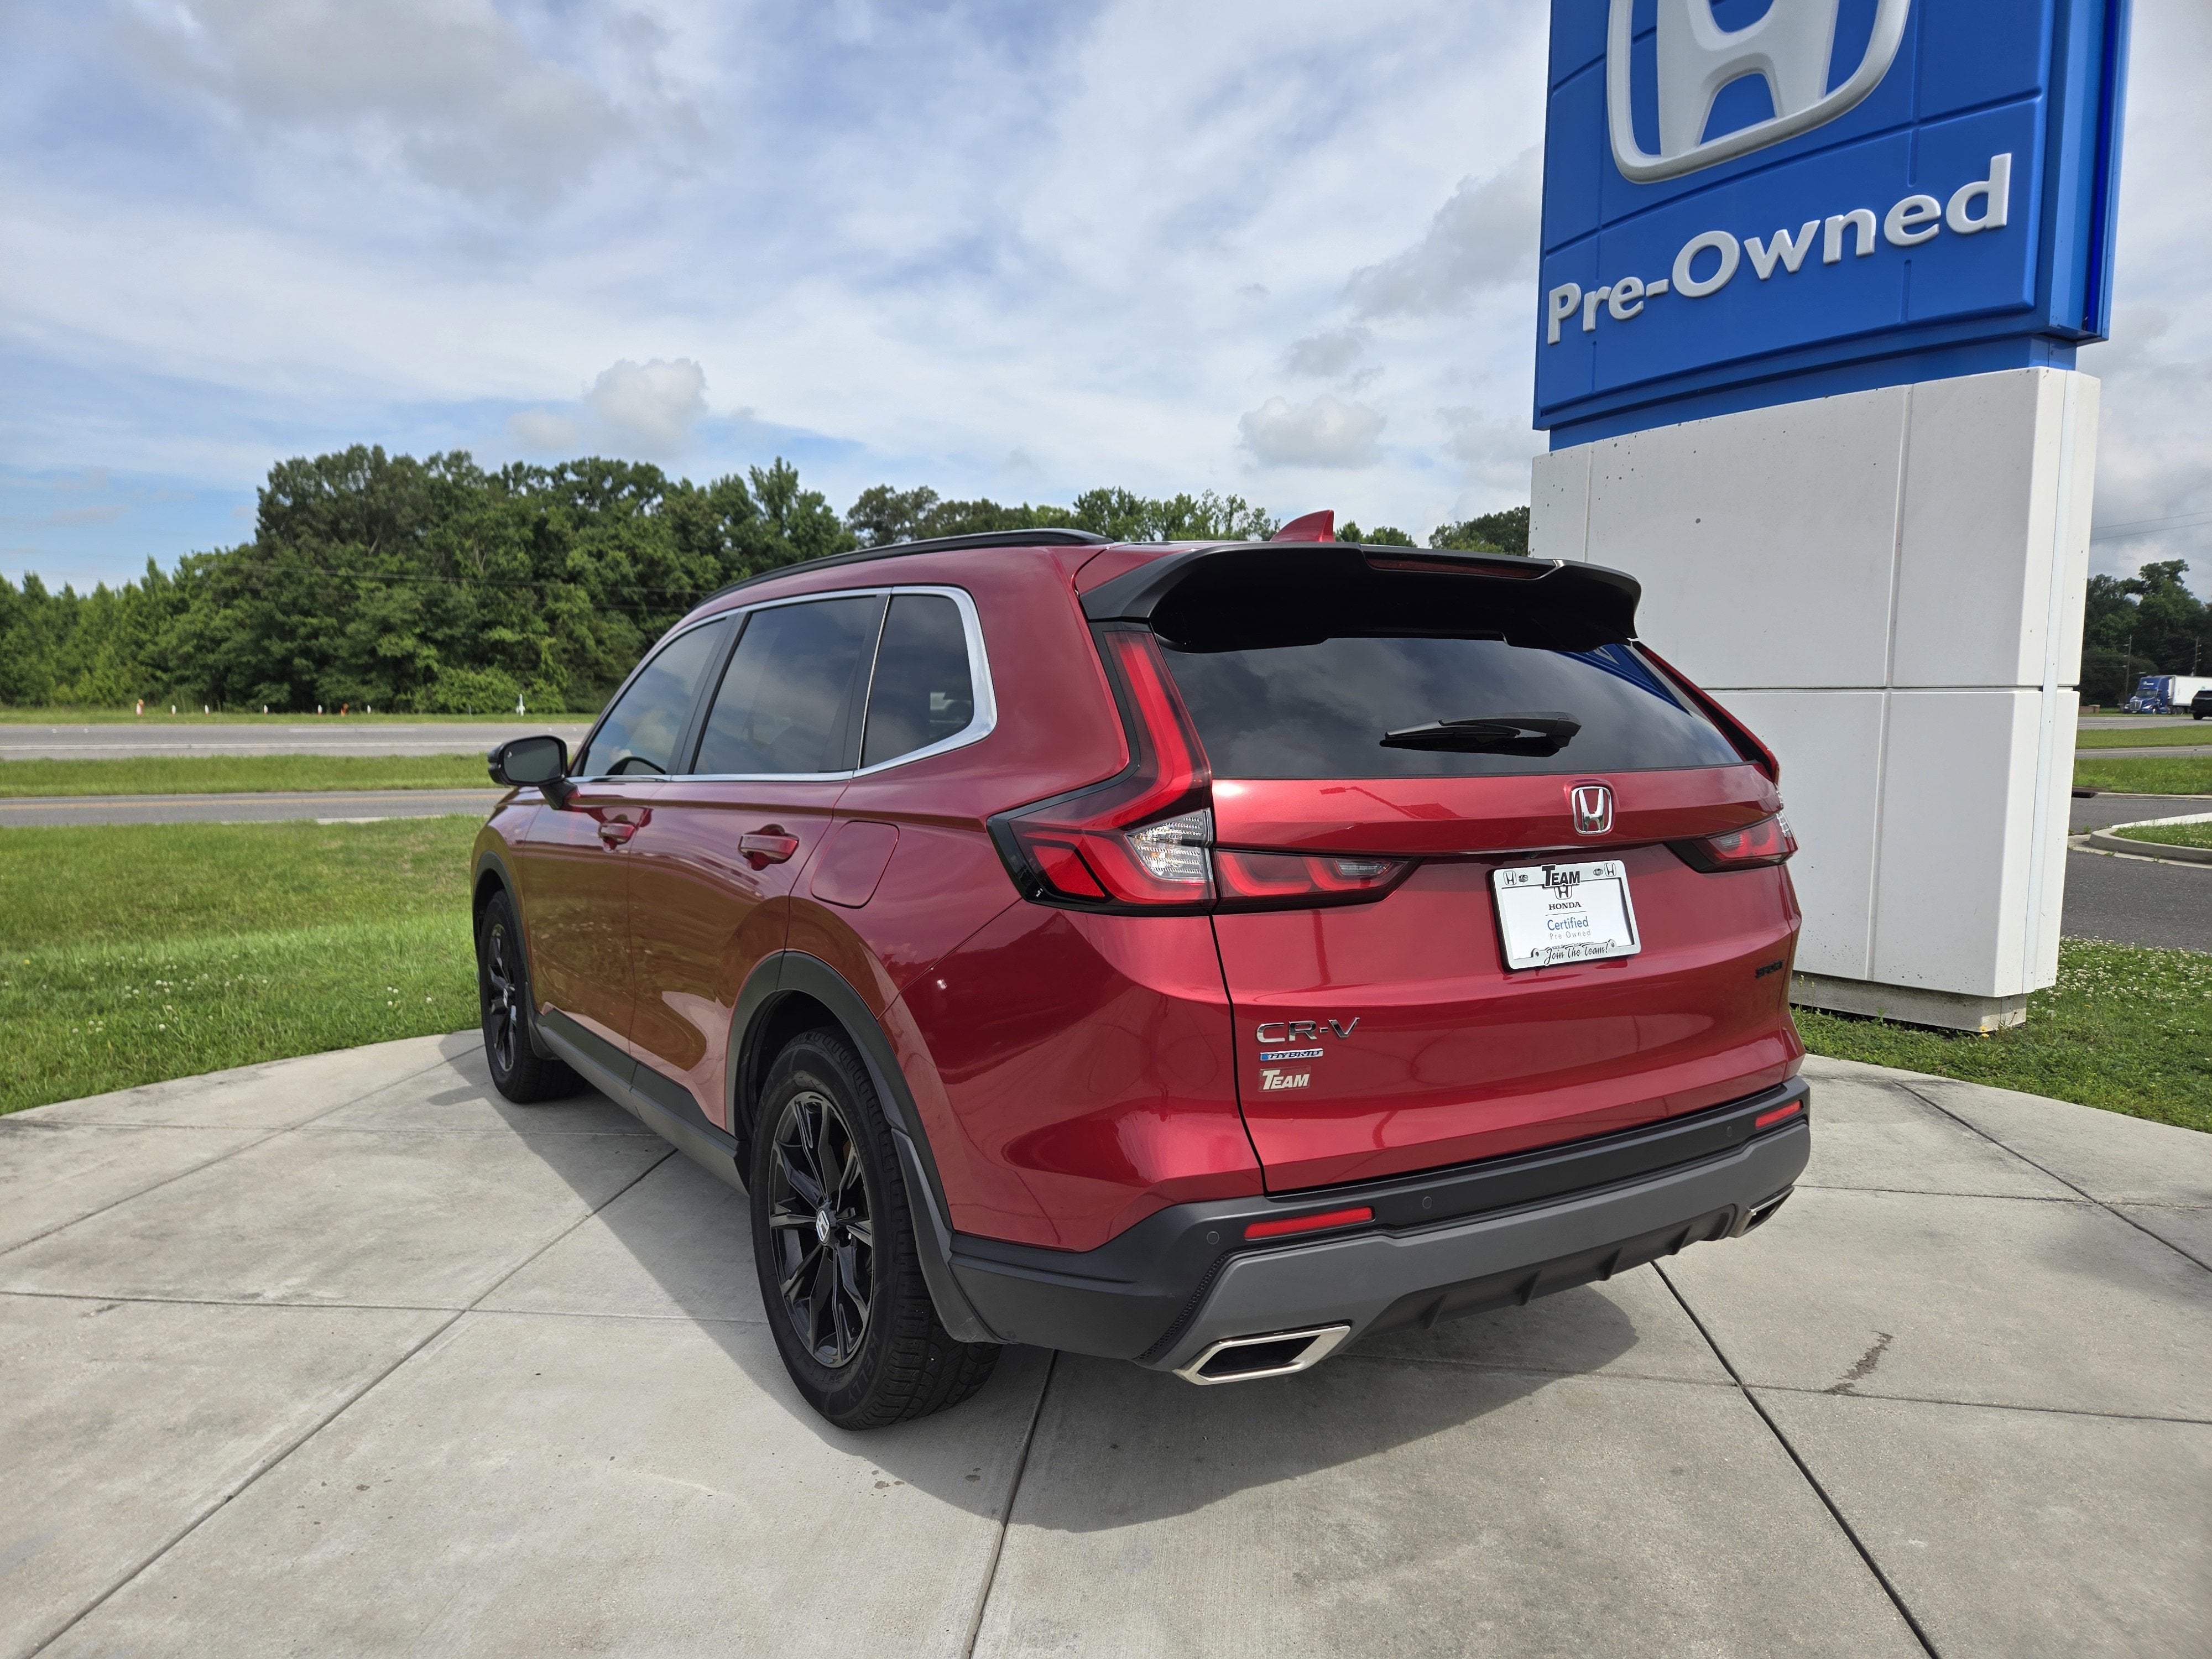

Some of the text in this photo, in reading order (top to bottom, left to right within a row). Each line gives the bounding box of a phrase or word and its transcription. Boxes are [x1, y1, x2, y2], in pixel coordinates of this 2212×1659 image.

[1547, 152, 2012, 345] Pre-Owned
[1541, 865, 1580, 886] TEAM
[1548, 901, 1582, 910] HONDA
[1547, 915, 1589, 931] Certified
[1550, 930, 1592, 940] Pre-Owned
[1543, 947, 1564, 965] Join
[1564, 945, 1582, 958] The
[1582, 943, 1609, 957] Team!
[1256, 1017, 1360, 1043] CR-V
[1270, 1050, 1321, 1059] HYBRID
[1262, 1069, 1310, 1091] TEAM
